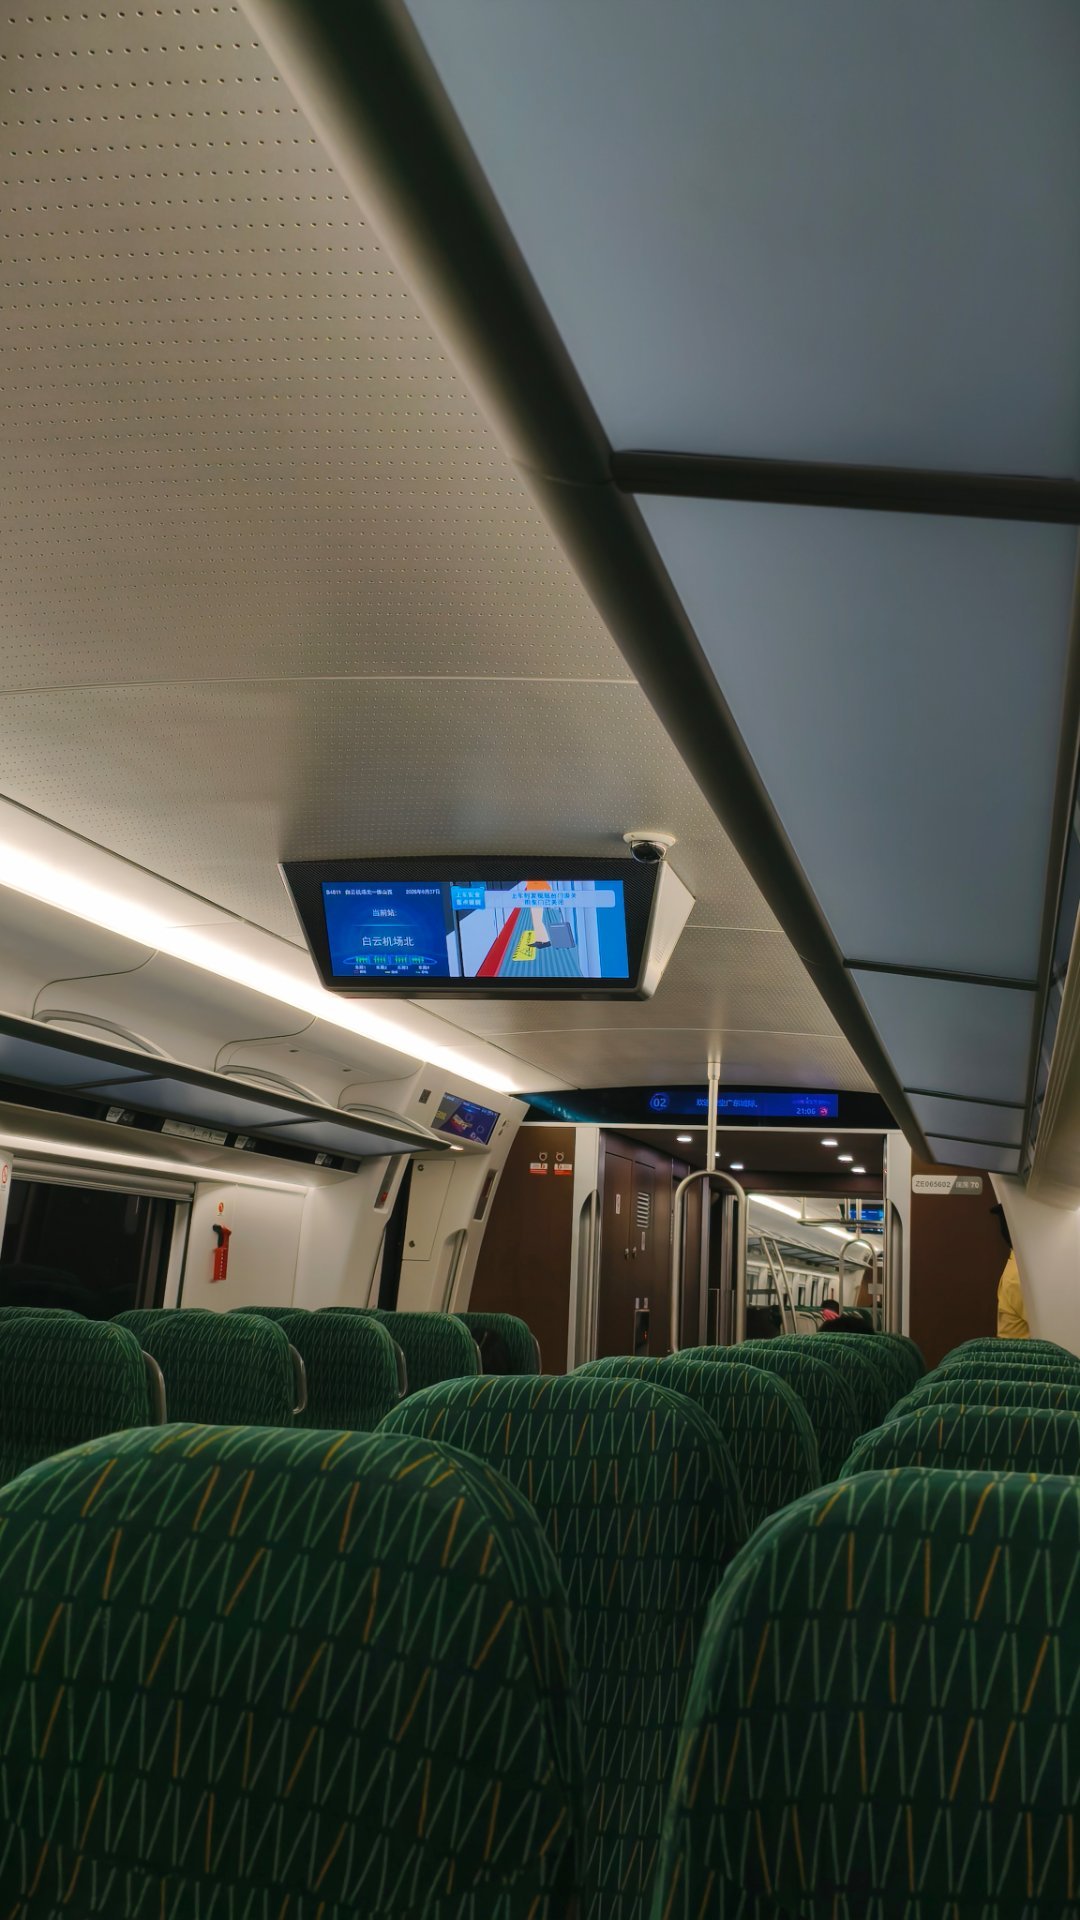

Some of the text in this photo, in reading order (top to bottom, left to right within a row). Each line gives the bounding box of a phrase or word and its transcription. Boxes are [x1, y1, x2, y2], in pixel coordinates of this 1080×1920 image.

[362, 936, 415, 947] 白云机场北
[653, 1098, 667, 1108] 02
[796, 1107, 816, 1115] 21:06
[970, 1181, 980, 1189] 70
